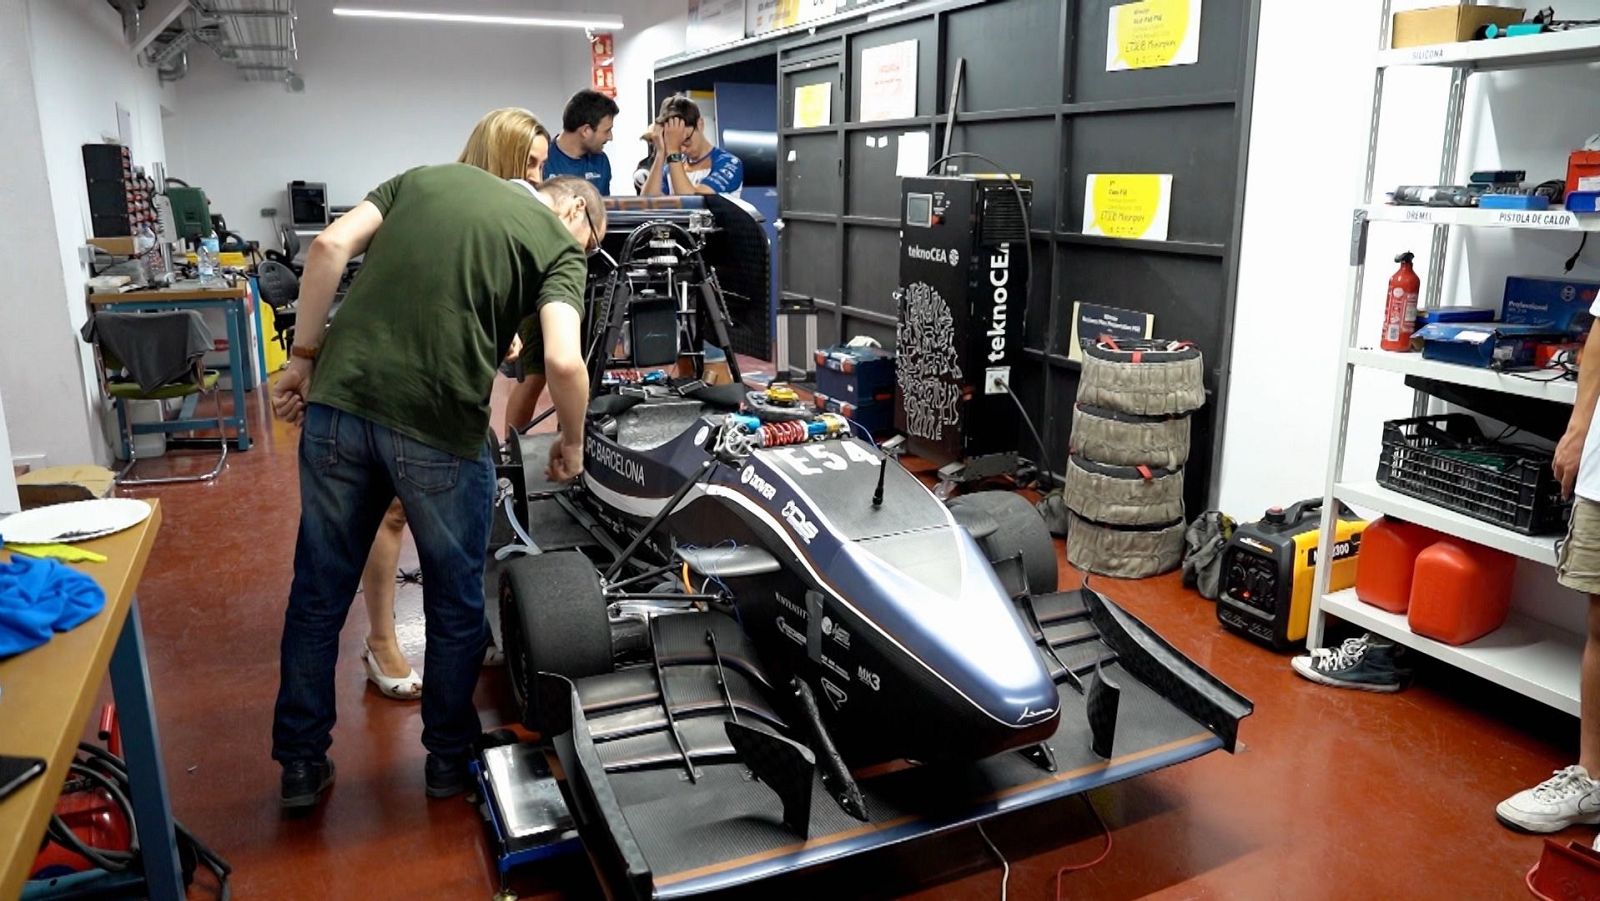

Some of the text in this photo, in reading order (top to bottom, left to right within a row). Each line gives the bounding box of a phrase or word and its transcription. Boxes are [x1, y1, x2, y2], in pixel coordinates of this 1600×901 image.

[1412, 48, 1443, 60] SILICONA
[1499, 213, 1570, 225] PISTOLA DE CALOR
[908, 245, 947, 263] teknoCEA
[585, 436, 645, 486] PC BARCELONA
[773, 440, 882, 476] E54
